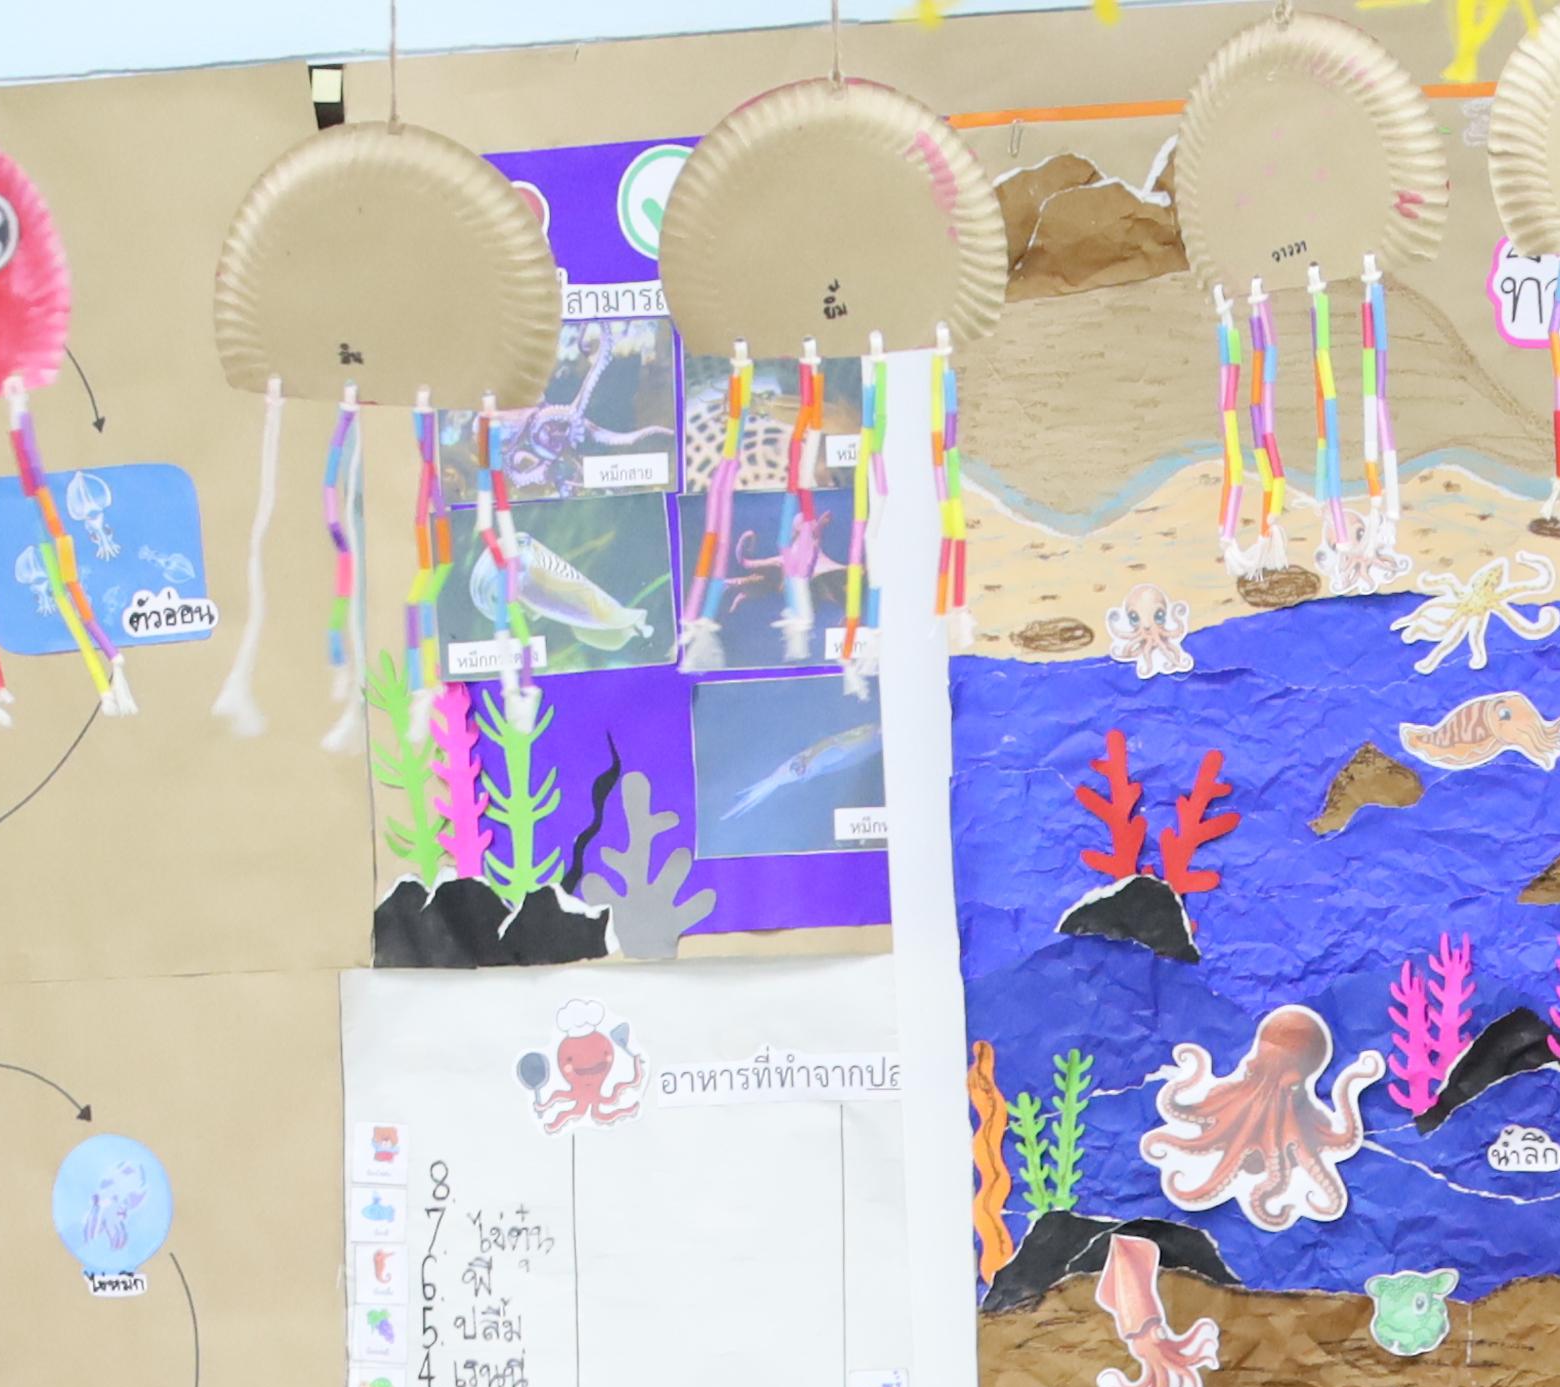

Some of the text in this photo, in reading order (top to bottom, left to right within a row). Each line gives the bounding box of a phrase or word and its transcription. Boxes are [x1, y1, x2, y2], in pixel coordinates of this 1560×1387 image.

[1491, 1128, 1559, 1166] น้ำลึก
[453, 1297, 522, 1342] ปลื้ม
